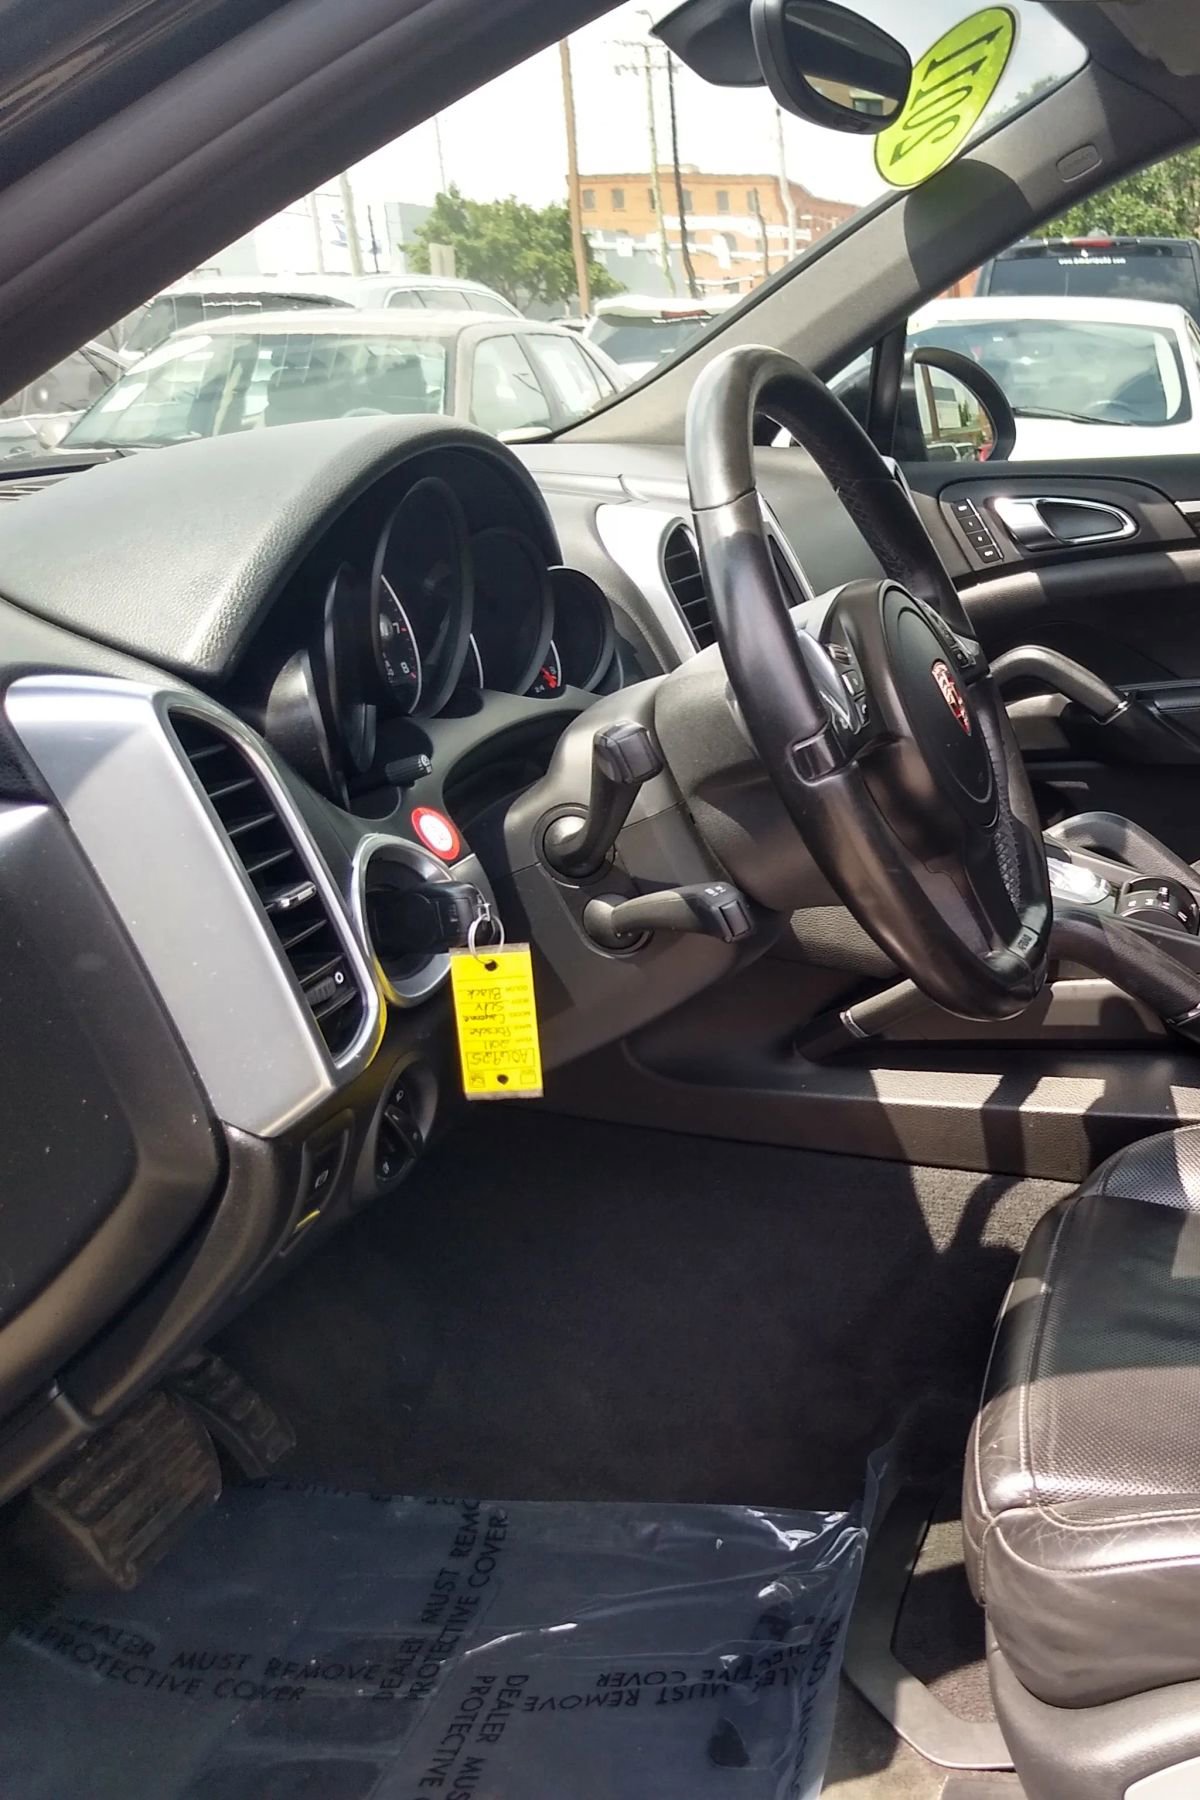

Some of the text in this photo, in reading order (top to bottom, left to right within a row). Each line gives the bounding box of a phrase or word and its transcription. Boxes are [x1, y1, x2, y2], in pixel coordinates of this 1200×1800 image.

[400, 661, 410, 674] 8
[468, 1515, 509, 1588] COVER
[421, 1567, 461, 1624] MUST
[170, 1650, 252, 1671] MUST
[264, 1656, 382, 1681] REMOVE
[596, 1671, 688, 1687] COVER
[213, 1677, 307, 1703] COVER
[523, 1688, 641, 1713] REMOVE
[418, 1675, 498, 1788] PROTECTIVE
[446, 1673, 531, 1800] DEALER MUS
